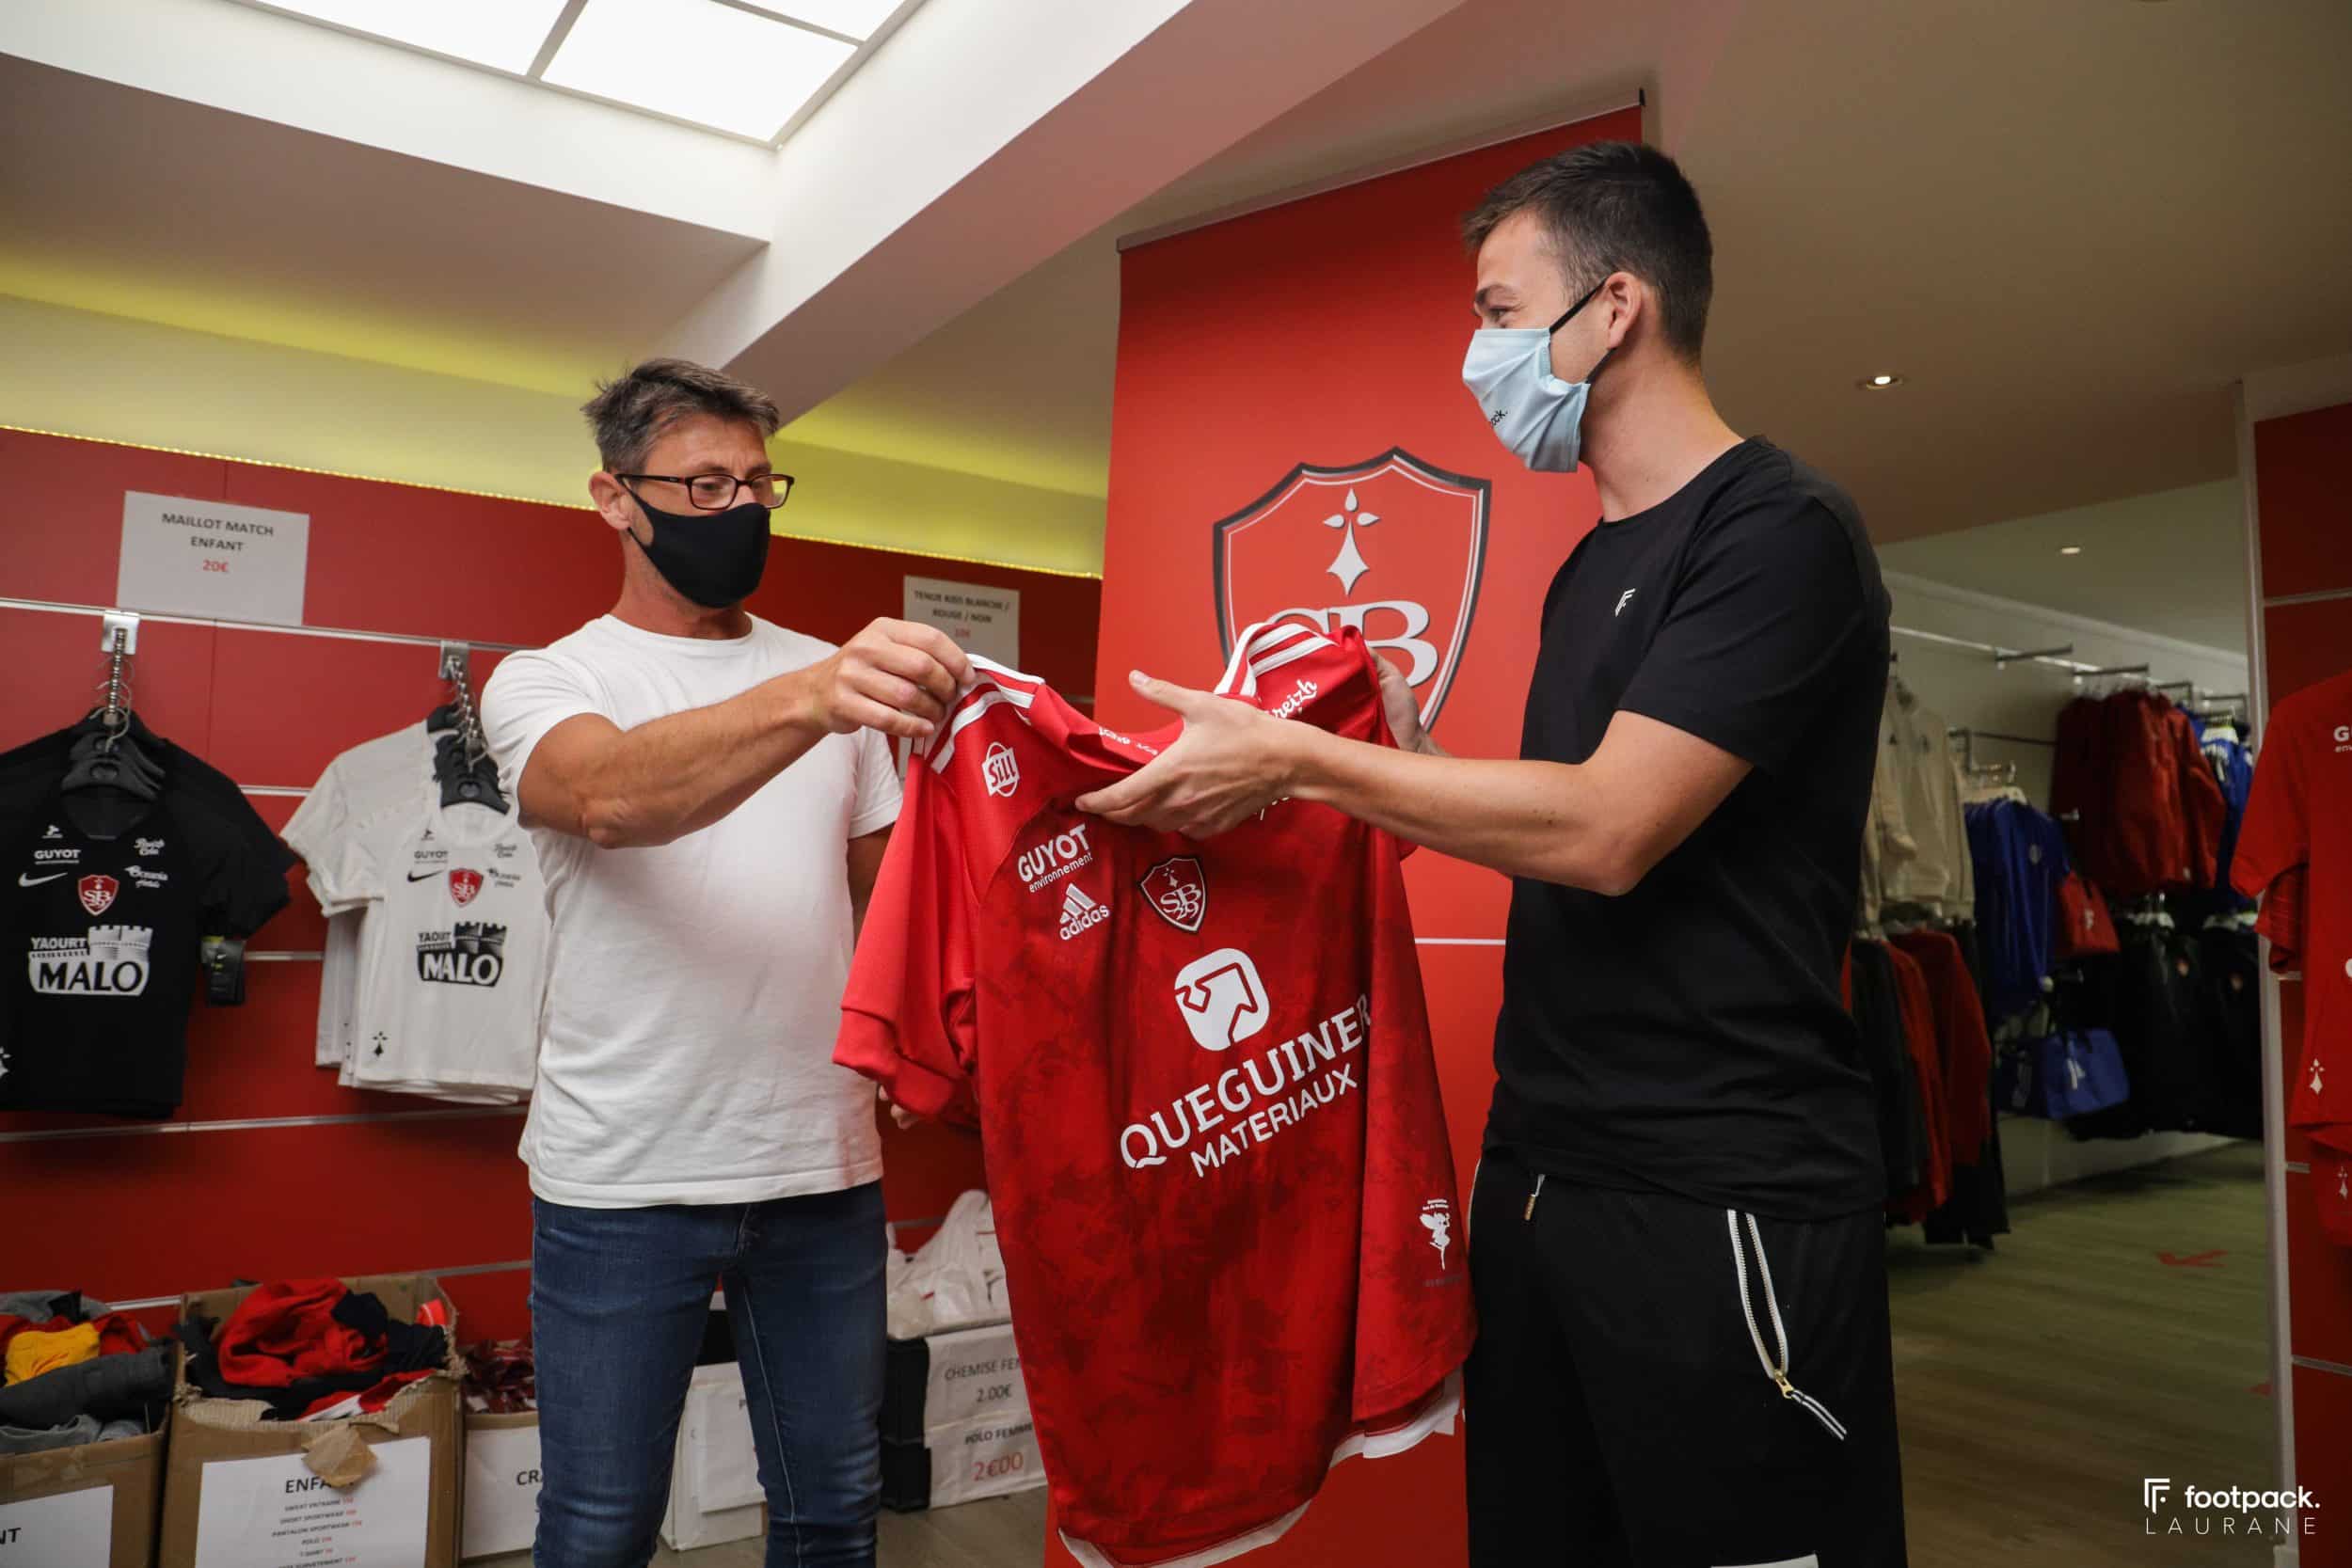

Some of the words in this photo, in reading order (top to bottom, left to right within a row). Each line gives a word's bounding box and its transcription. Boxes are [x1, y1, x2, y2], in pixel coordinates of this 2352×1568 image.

[162, 514, 221, 531] MAILLOT
[226, 521, 274, 536] MATCH
[191, 536, 244, 551] ENFANT
[203, 560, 229, 573] 20€
[1264, 679, 1317, 719] reizh
[989, 754, 1017, 787] Sill
[34, 848, 81, 860] GUYOT
[414, 850, 448, 859] GUYOT
[1018, 823, 1090, 882] GUYOT
[1029, 852, 1092, 893] environnement
[1059, 904, 1110, 940] adidas
[31, 937, 87, 950] YAOURT
[39, 960, 142, 992] MALO
[423, 952, 499, 985] MALO
[1120, 993, 1371, 1168] QUEGUINER
[1190, 1064, 1358, 1178] MATERIAUX
[945, 1360, 996, 1381] CHEMISE
[964, 1430, 993, 1445] POLO
[516, 1469, 542, 1485] CR
[971, 1451, 1024, 1481] 2€00
